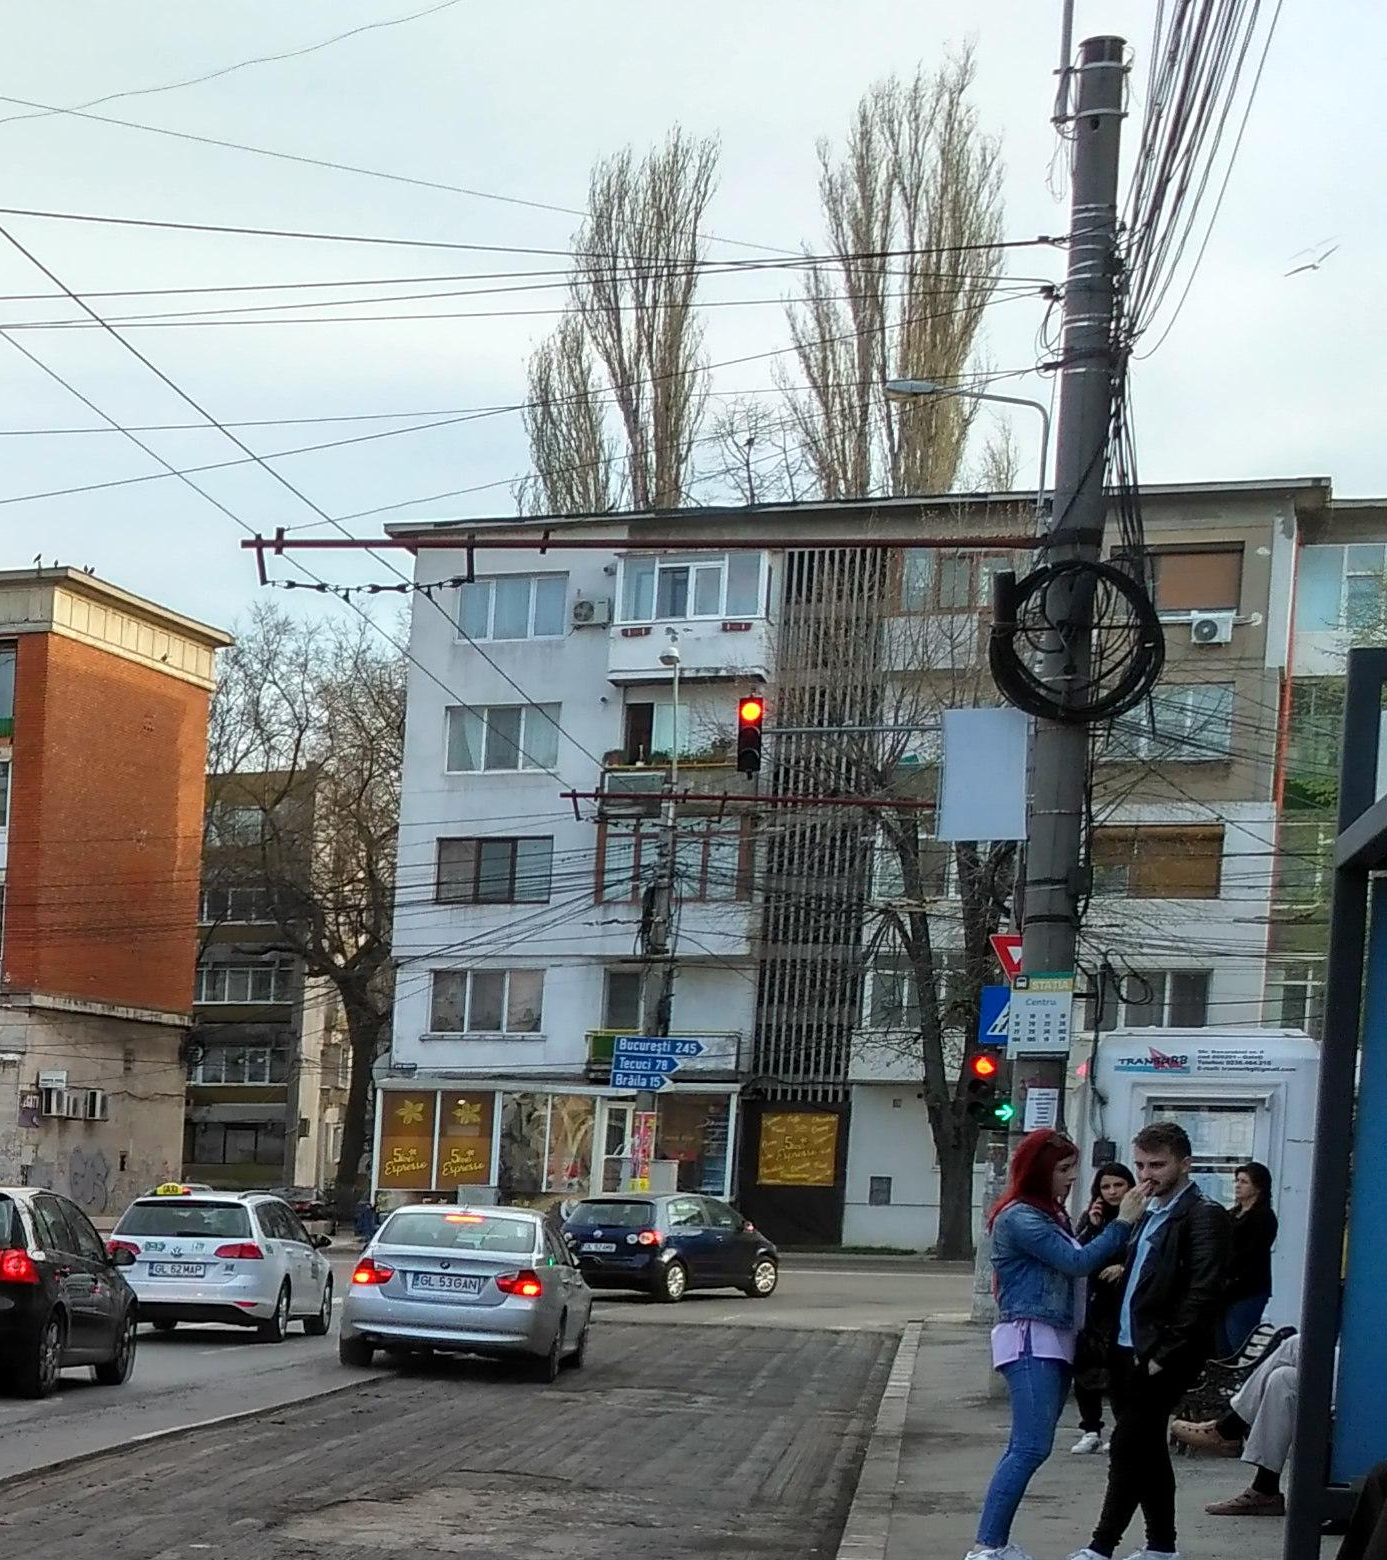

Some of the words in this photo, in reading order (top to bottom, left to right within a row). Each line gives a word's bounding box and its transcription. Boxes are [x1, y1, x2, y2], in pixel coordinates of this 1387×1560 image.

[1026, 998, 1057, 1006] Centru
[675, 1042, 697, 1054] 245
[619, 1056, 651, 1070] Tecuci
[656, 1059, 668, 1070] 78
[1118, 1055, 1188, 1065] TRANSURB
[615, 1074, 647, 1087] Brăila
[650, 1077, 660, 1088] 15
[384, 1161, 427, 1176] Espresso
[442, 1161, 485, 1177] Espresso
[155, 1264, 167, 1272] GL
[421, 1275, 434, 1287] GL
